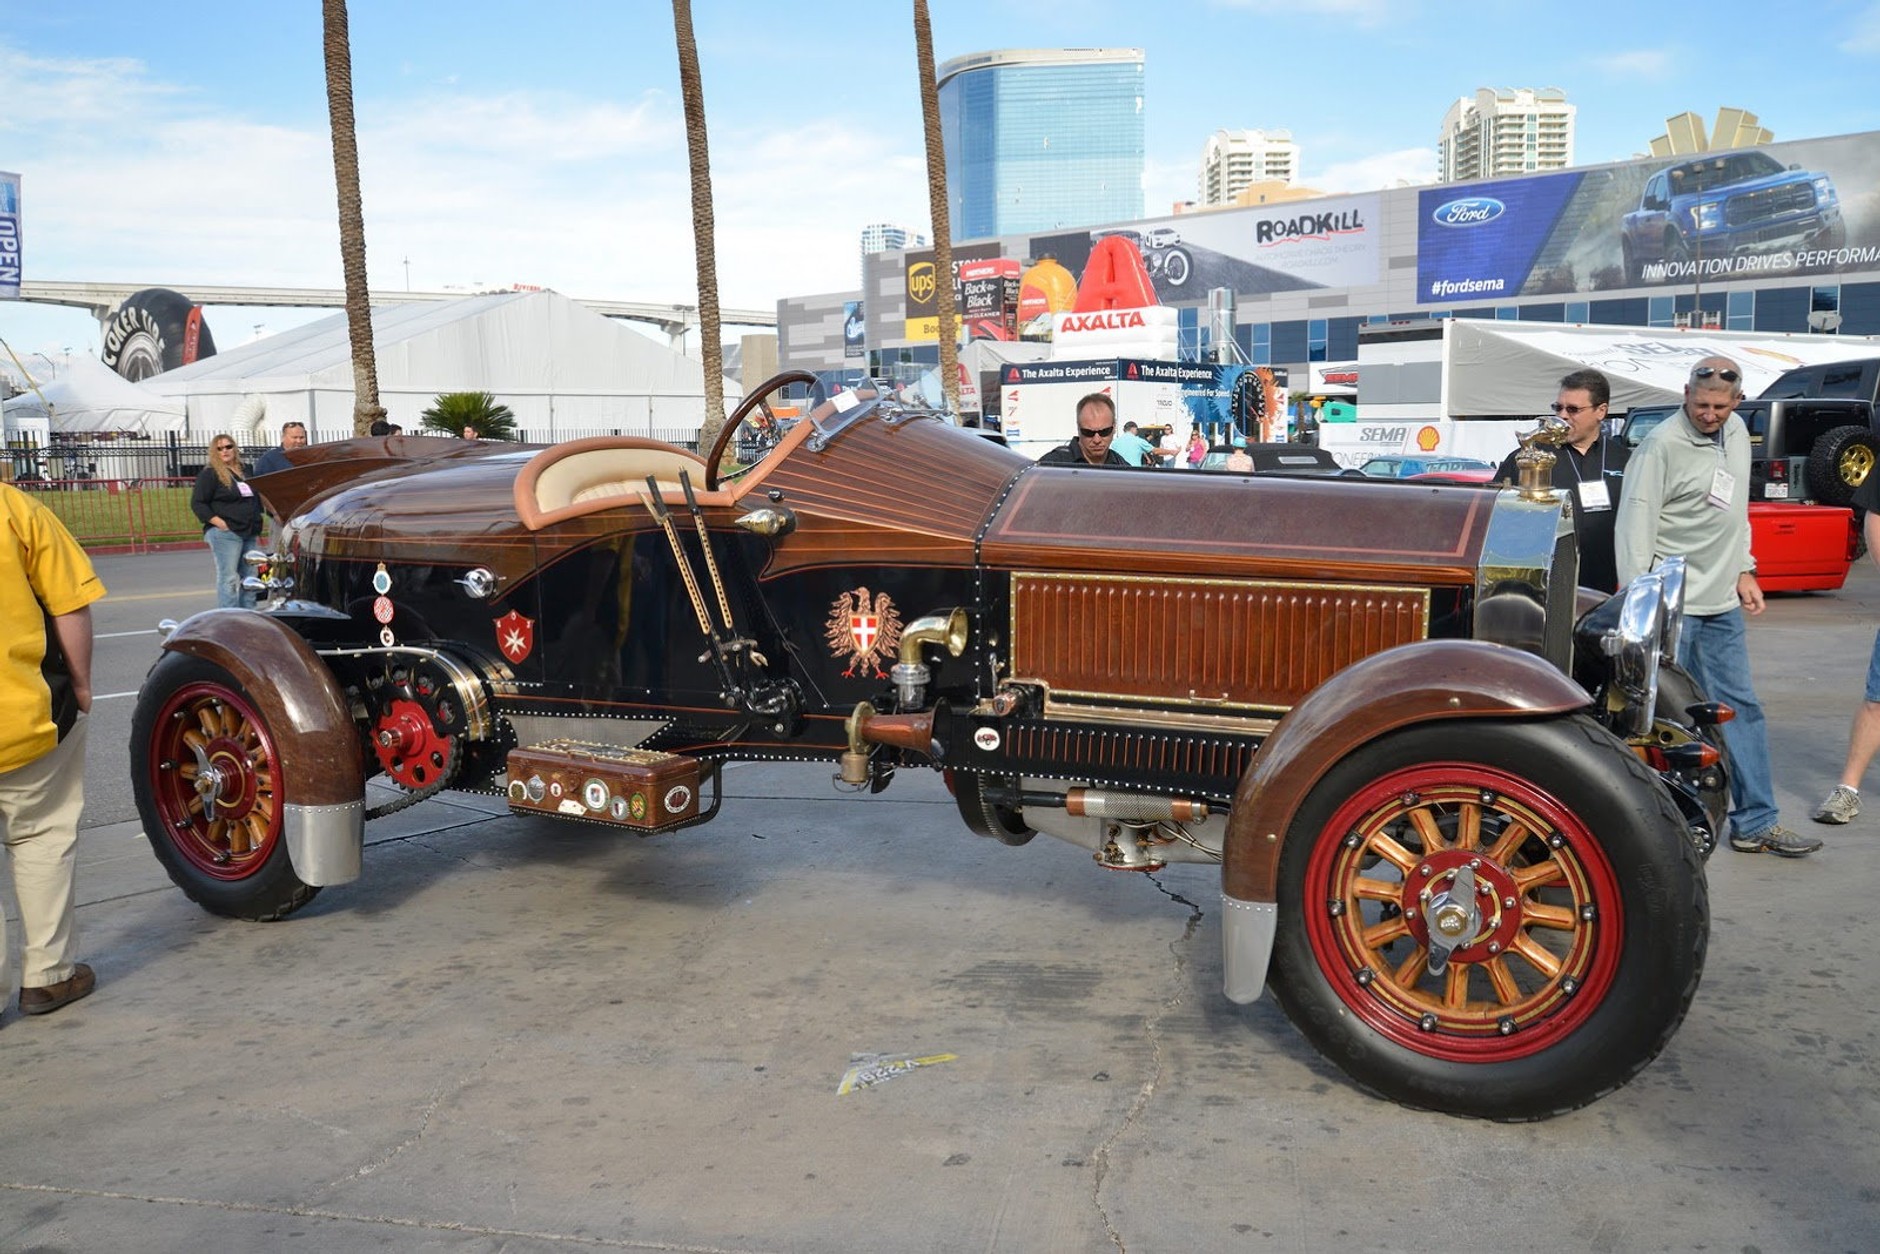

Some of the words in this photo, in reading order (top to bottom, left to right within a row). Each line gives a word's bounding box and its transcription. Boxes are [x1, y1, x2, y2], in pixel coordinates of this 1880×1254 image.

[1446, 202, 1491, 222] Ford
[1256, 209, 1363, 243] ROADKILL
[0, 220, 20, 282] OPEN
[1642, 258, 1734, 279] INNOVATION
[1735, 252, 1793, 272] DRIVES
[911, 274, 933, 297] ups
[1431, 278, 1504, 296] #fordsema
[966, 294, 995, 308] Black
[1061, 311, 1146, 332] AXALTA
[103, 307, 140, 367] COKER
[1022, 369, 1037, 378] The
[1038, 368, 1064, 378] Axalta
[1065, 366, 1111, 378] Experience
[1141, 365, 1154, 376] The
[1156, 366, 1177, 377] Axalta
[1178, 368, 1213, 380] Experience
[1360, 428, 1406, 441] SEMA
